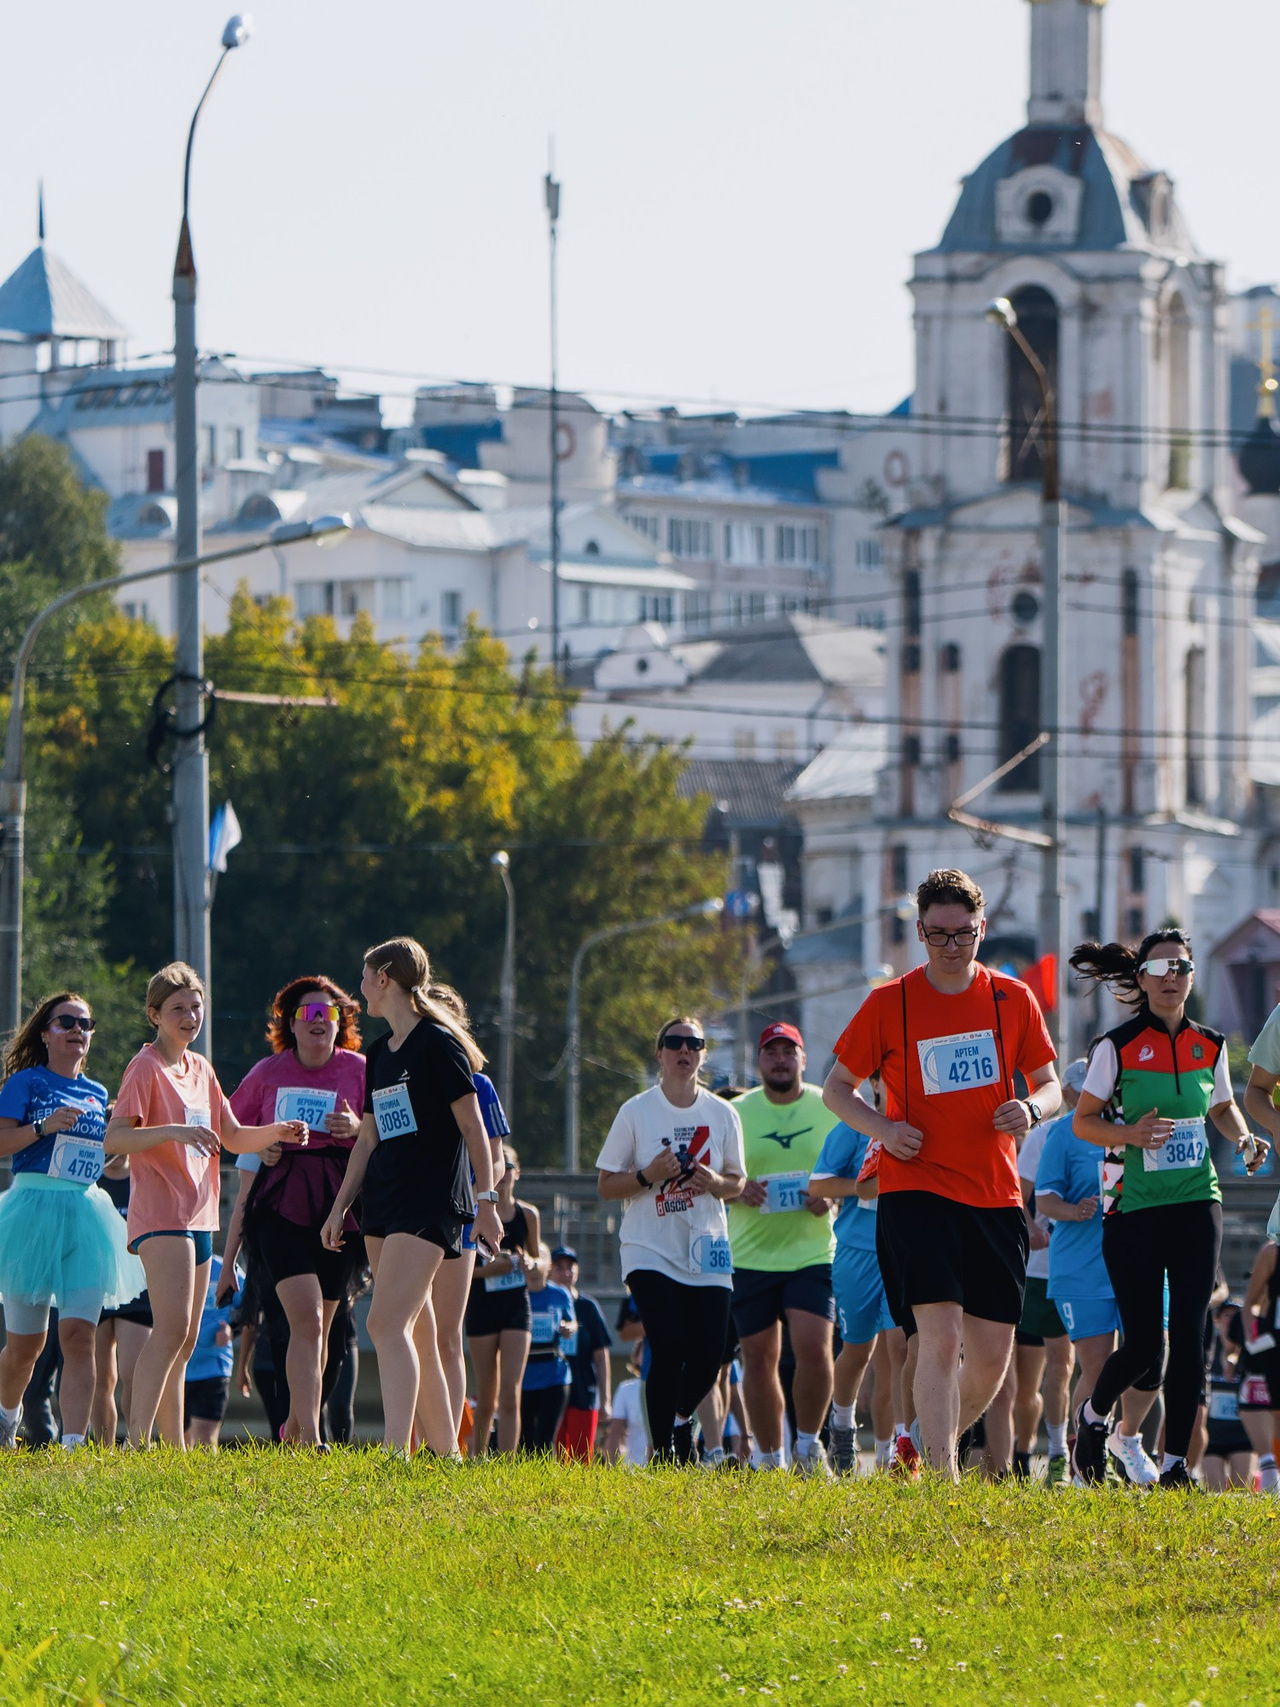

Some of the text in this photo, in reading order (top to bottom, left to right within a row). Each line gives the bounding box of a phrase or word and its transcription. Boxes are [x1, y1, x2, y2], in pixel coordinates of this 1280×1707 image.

[955, 1046, 979, 1058] АРТЕМ
[949, 1057, 993, 1083] 4216
[297, 1098, 327, 1108] ВЕРОНИКА
[297, 1108, 324, 1126] 337
[380, 1108, 411, 1133] 3085
[1166, 1141, 1203, 1163] 3842
[68, 1159, 100, 1180] 4762
